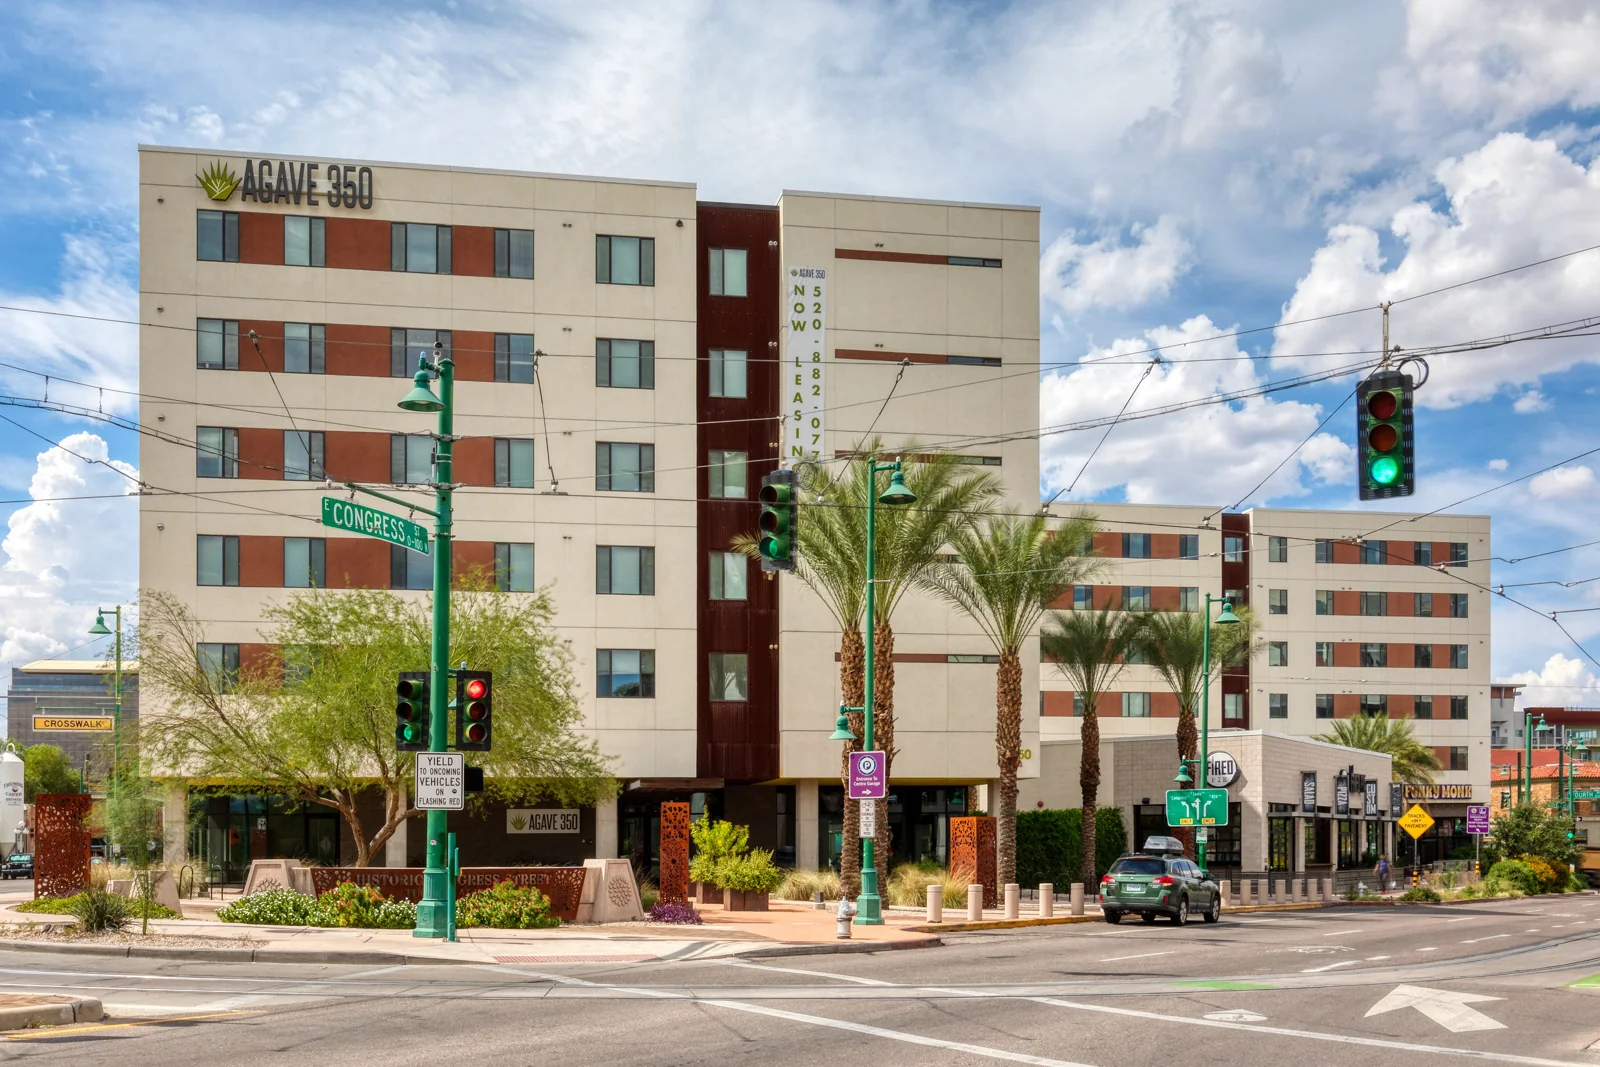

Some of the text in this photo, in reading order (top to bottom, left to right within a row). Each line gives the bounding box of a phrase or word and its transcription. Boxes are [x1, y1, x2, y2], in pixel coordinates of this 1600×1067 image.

[241, 159, 373, 209] AGAVE 350
[799, 268, 826, 279] AGAVE 350
[791, 285, 806, 331] NOW
[811, 286, 822, 459] 520-882-077
[324, 499, 420, 542] E CONGRESS ST
[43, 719, 102, 728] CROSSWALK
[427, 757, 454, 766] YIELD
[1207, 757, 1234, 776] FIRED
[419, 767, 461, 775] TO ONCOMING
[419, 777, 461, 787] VEHICLES
[435, 788, 445, 796] ON
[1304, 781, 1315, 805] SALAD
[1337, 786, 1347, 806] PIZZA
[1404, 785, 1440, 799] FUNKY
[1441, 785, 1472, 799] MONK
[419, 797, 461, 806] FLASHING RED
[528, 813, 578, 831] AGAVE 350
[356, 873, 424, 887] HISTORIC
[456, 873, 501, 887] GRESS
